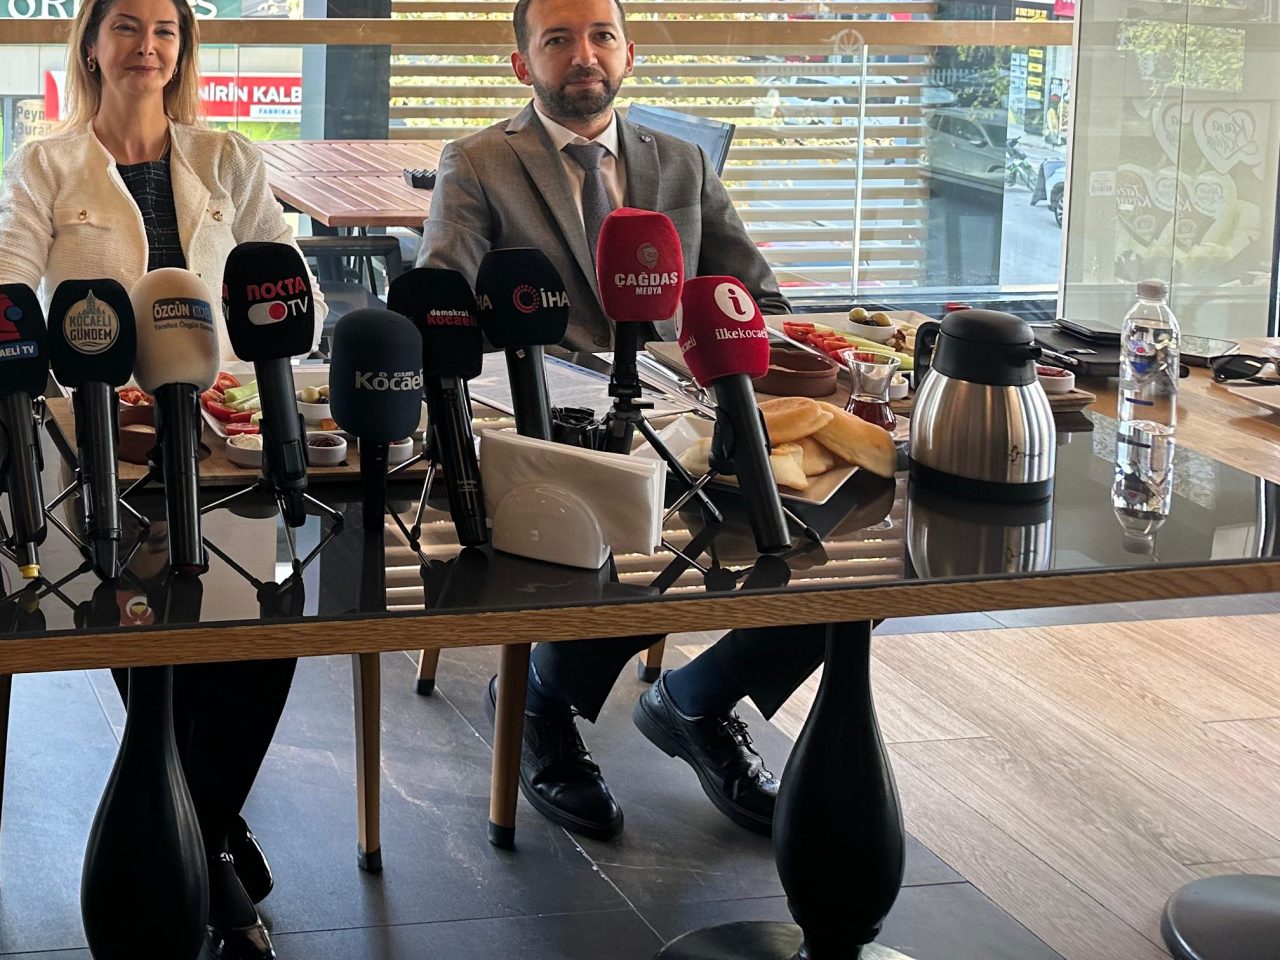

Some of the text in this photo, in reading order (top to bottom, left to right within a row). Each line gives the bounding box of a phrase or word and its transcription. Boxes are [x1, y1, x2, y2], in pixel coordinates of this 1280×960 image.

[615, 271, 678, 288] ÇAĞDAŞ
[541, 287, 570, 308] İHA
[635, 287, 662, 296] MEDYA
[154, 301, 190, 319] ÖZGÜN
[287, 296, 308, 316] TV
[476, 294, 493, 311] HA
[70, 327, 112, 340] GÜNDEM
[22, 345, 34, 354] TV
